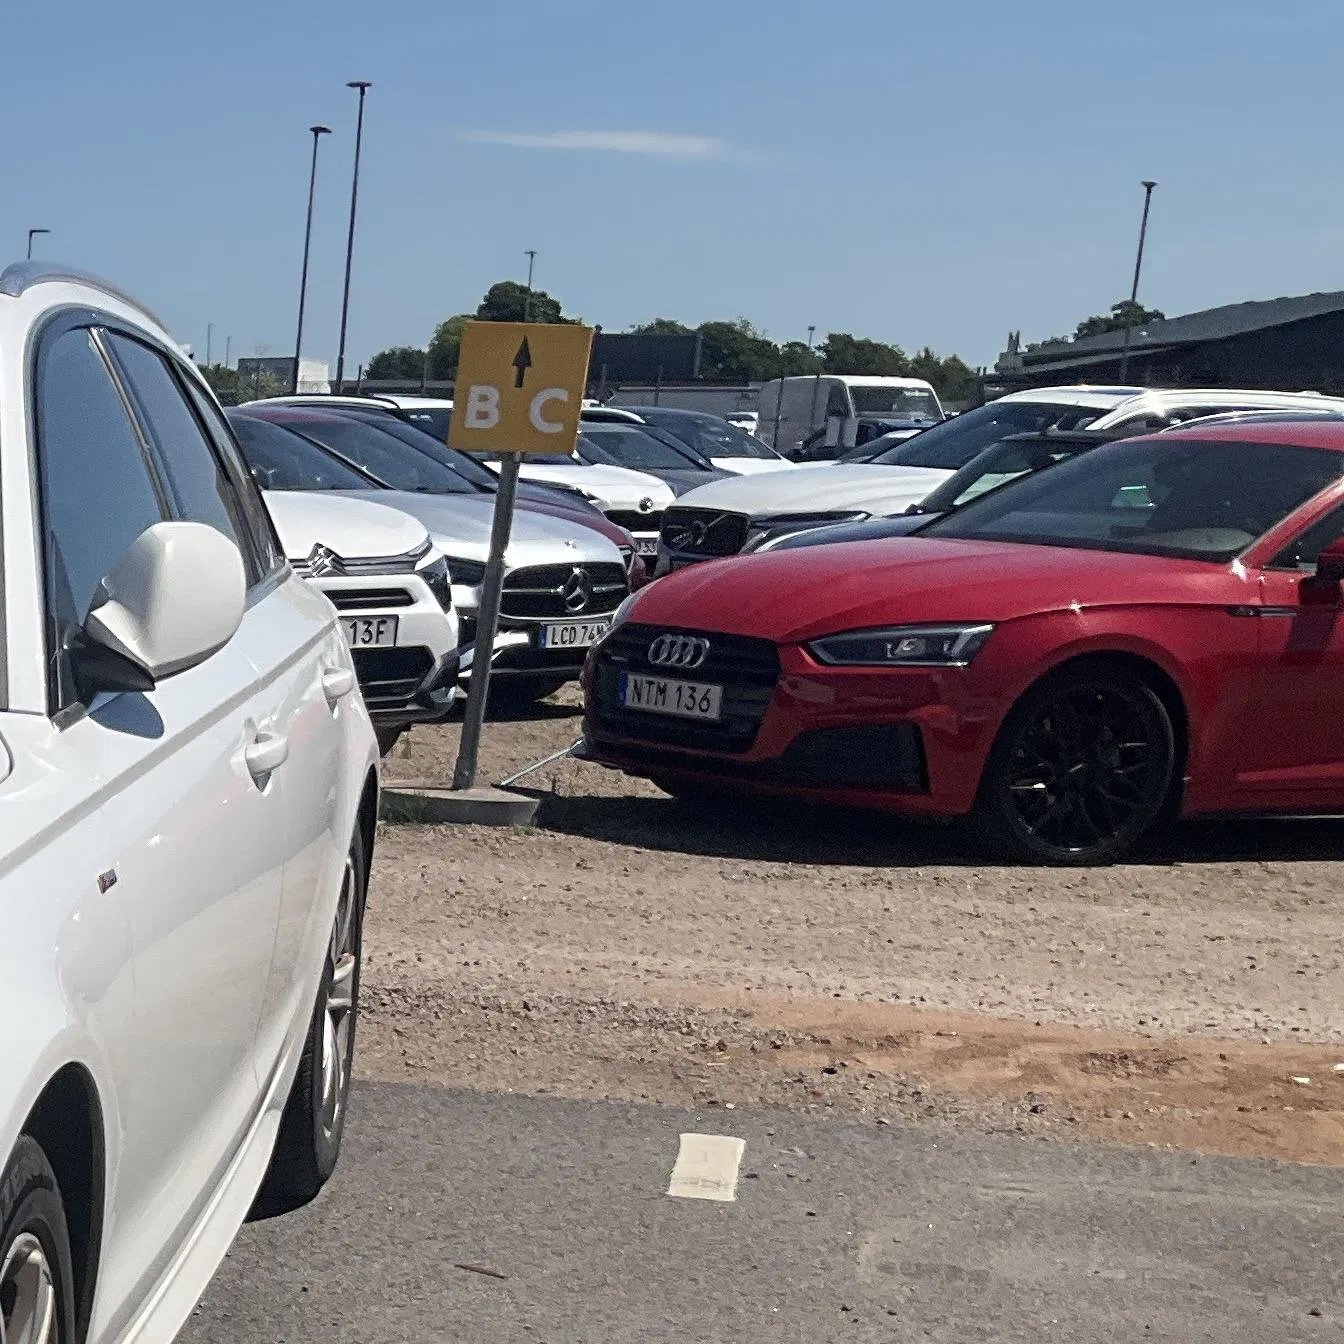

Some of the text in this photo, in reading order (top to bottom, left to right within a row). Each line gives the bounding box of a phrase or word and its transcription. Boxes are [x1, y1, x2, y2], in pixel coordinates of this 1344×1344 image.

[464, 384, 568, 433] B C
[349, 619, 387, 645] 13F
[551, 625, 577, 645] LCD
[632, 679, 711, 713] NTM 136
